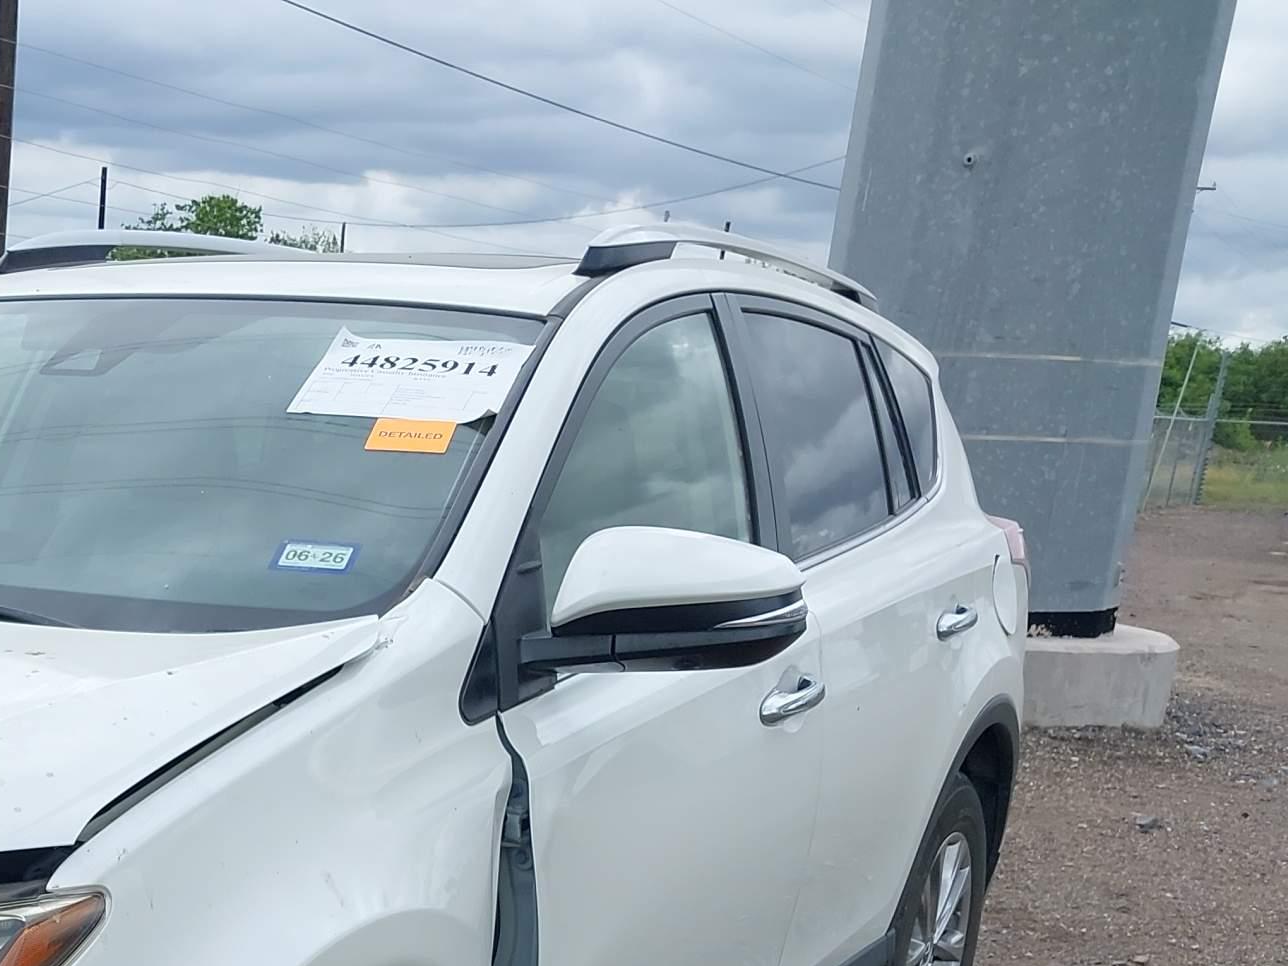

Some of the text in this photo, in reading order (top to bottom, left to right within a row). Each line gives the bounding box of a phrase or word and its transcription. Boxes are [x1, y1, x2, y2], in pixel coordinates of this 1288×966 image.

[341, 354, 498, 377] 44825914
[378, 430, 444, 440] DETAILED
[285, 549, 347, 564] 06 26
